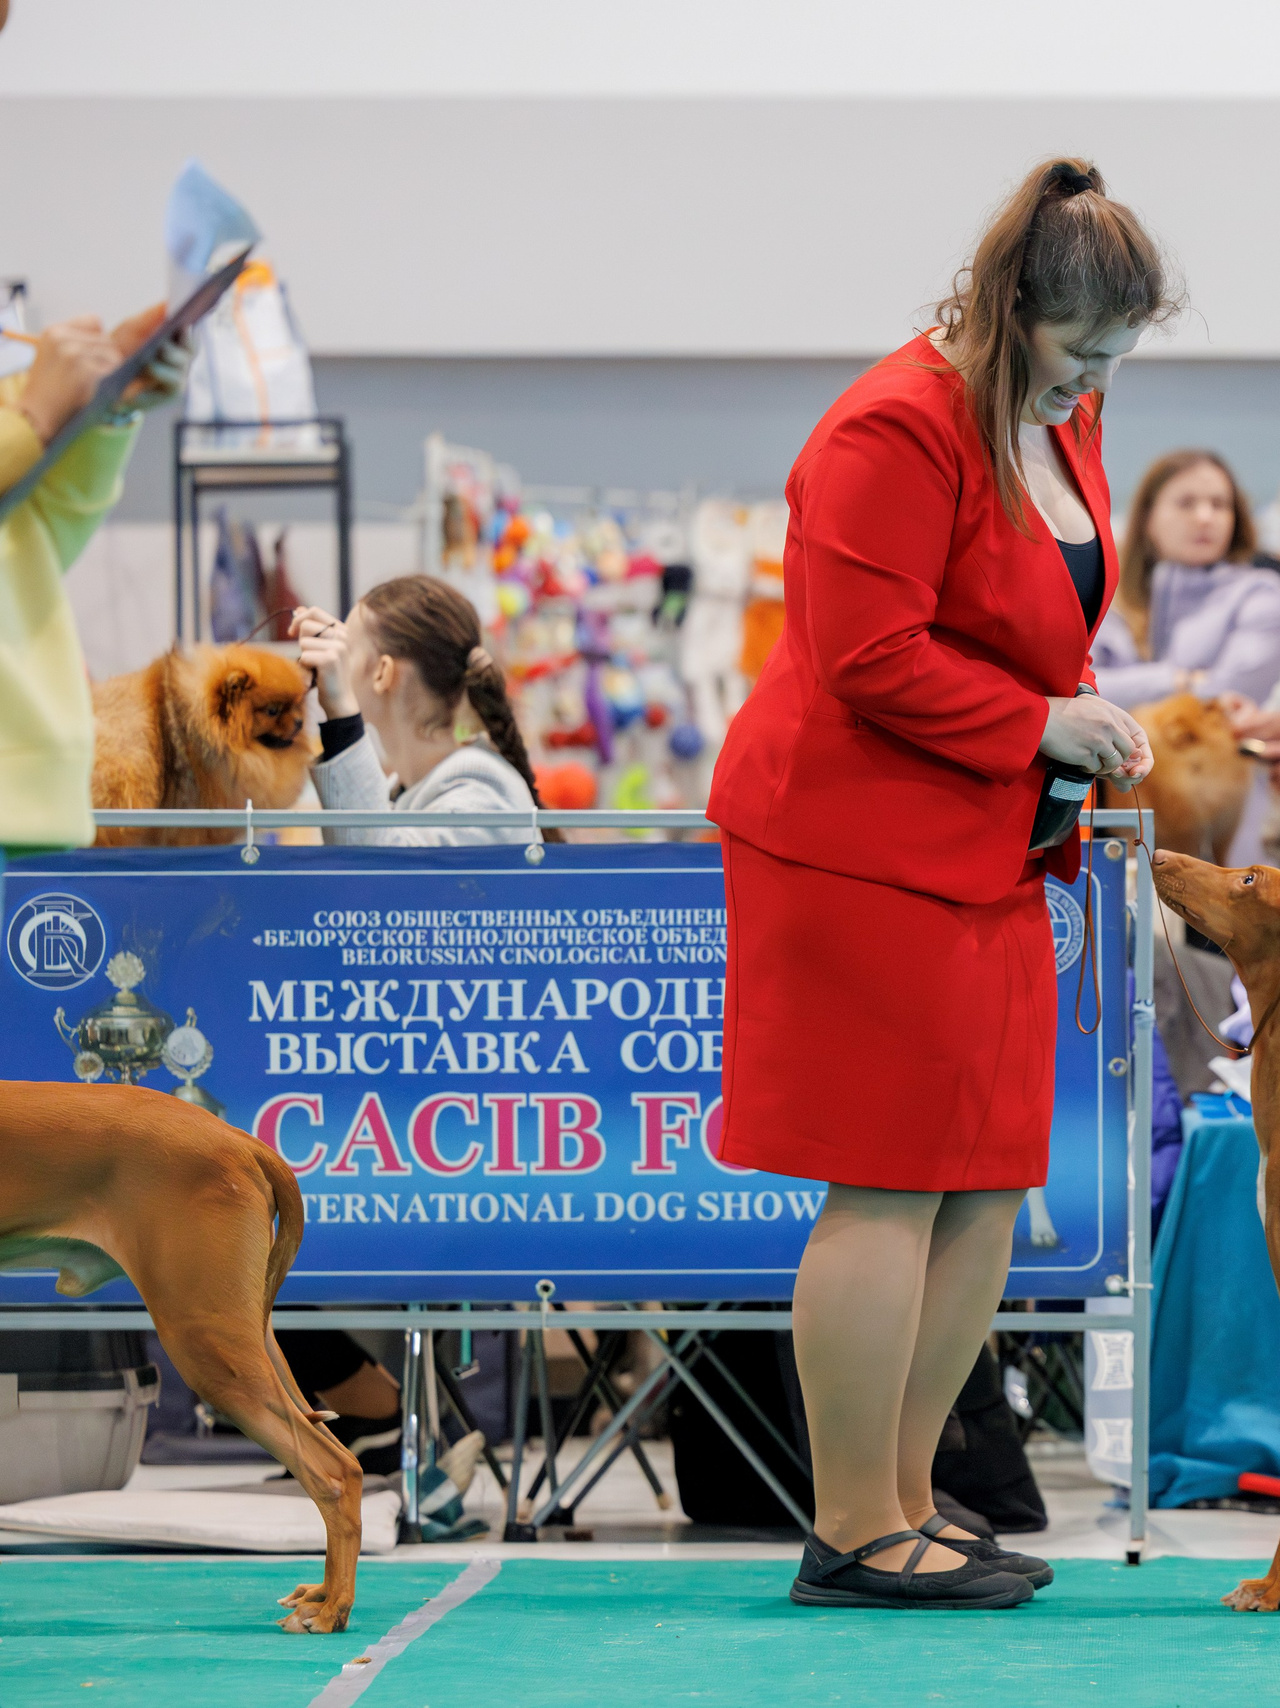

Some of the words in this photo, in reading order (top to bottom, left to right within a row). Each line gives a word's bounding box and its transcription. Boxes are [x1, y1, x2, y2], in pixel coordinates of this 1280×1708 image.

[313, 910, 381, 928] СОЮЗ
[385, 909, 578, 929] ОБЩЕСТВЕННЫХ
[582, 908, 727, 928] ОБЪЕДИНЕН
[432, 928, 649, 946] КИНОЛОГИЧЕСКОЕ
[651, 927, 727, 946] ОБЪЕД
[341, 946, 495, 966] BELORUSSIAN
[500, 946, 652, 965] CINOLOGICAL
[656, 945, 727, 964] UNION
[248, 978, 726, 1030] МЕЖДУНАРОДН
[265, 1031, 590, 1075] ВЫСТАВКА
[620, 1030, 724, 1073] СОБ
[252, 1091, 606, 1177] CACIB
[301, 1192, 585, 1224] TERNATIONAL
[593, 1191, 687, 1222] DOG
[696, 1190, 828, 1222] SHOW
